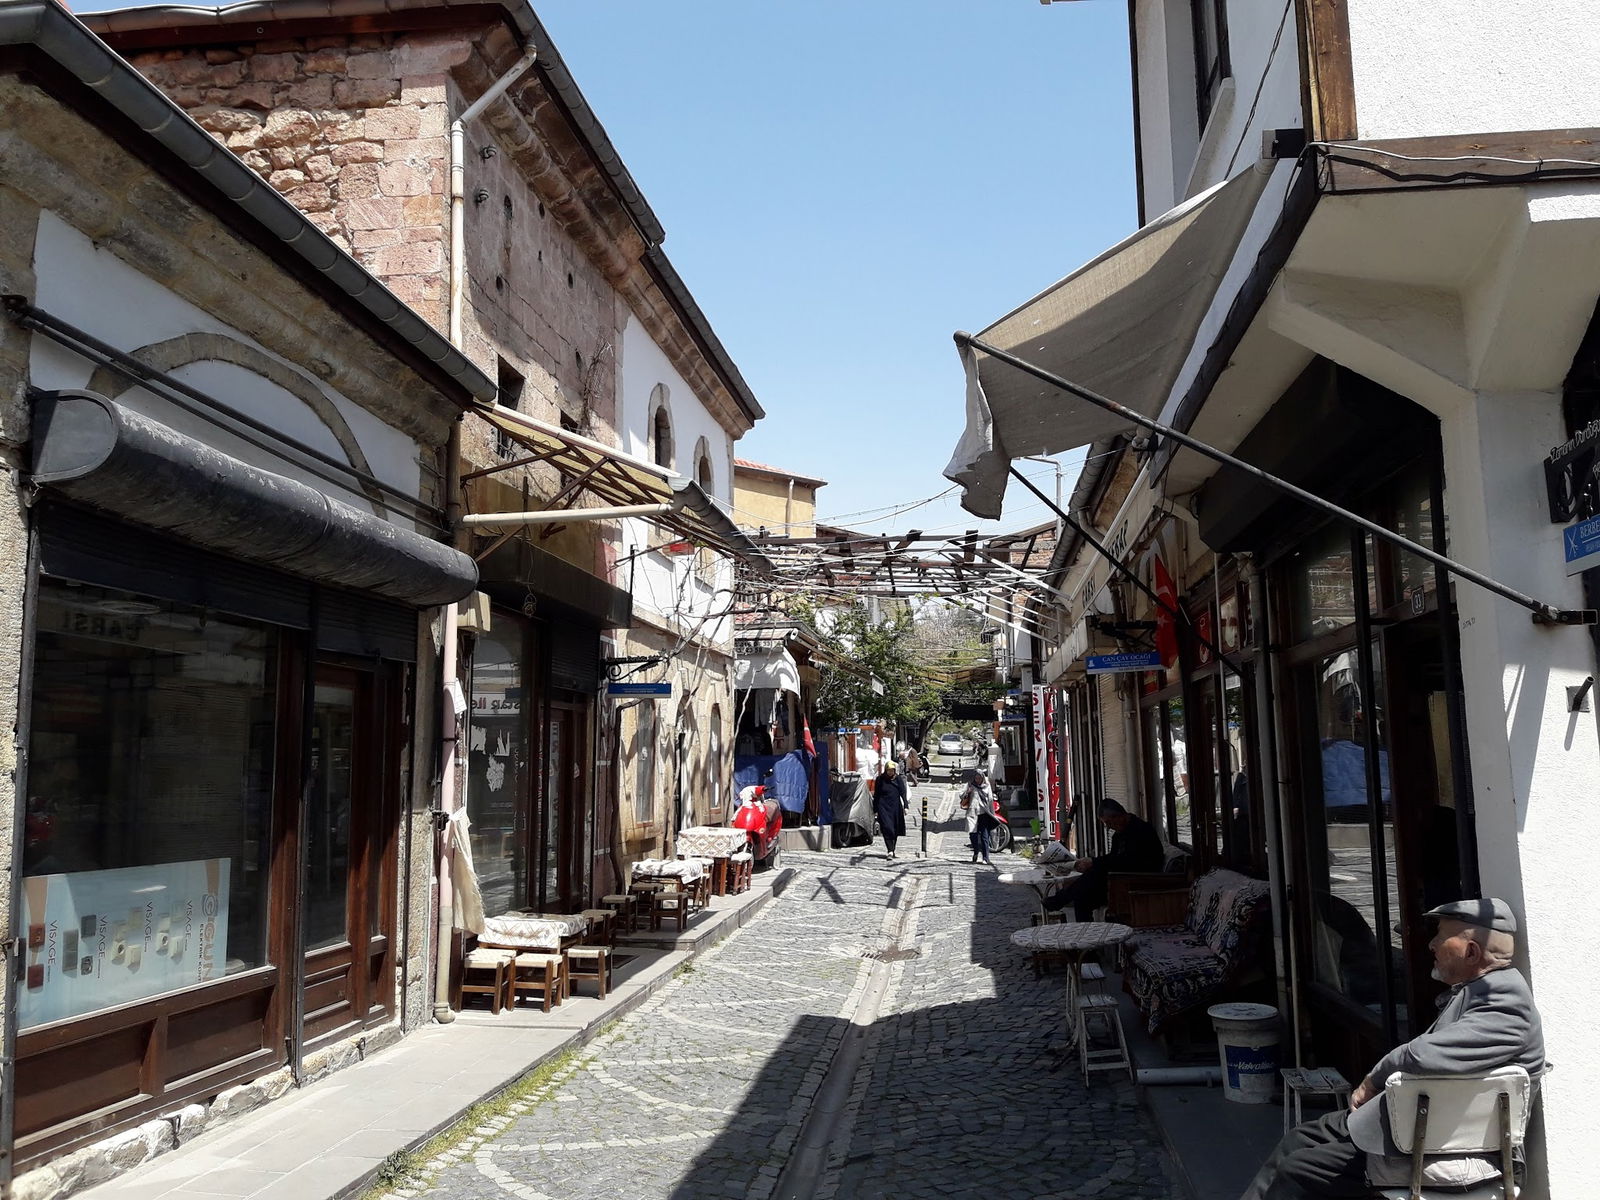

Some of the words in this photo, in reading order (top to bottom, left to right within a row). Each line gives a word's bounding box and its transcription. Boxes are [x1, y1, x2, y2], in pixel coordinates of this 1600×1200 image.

[98, 915, 109, 959] VISAGE
[144, 901, 154, 942] VISAGE
[185, 900, 193, 939] VISAGE
[48, 919, 58, 965] VISAGE
